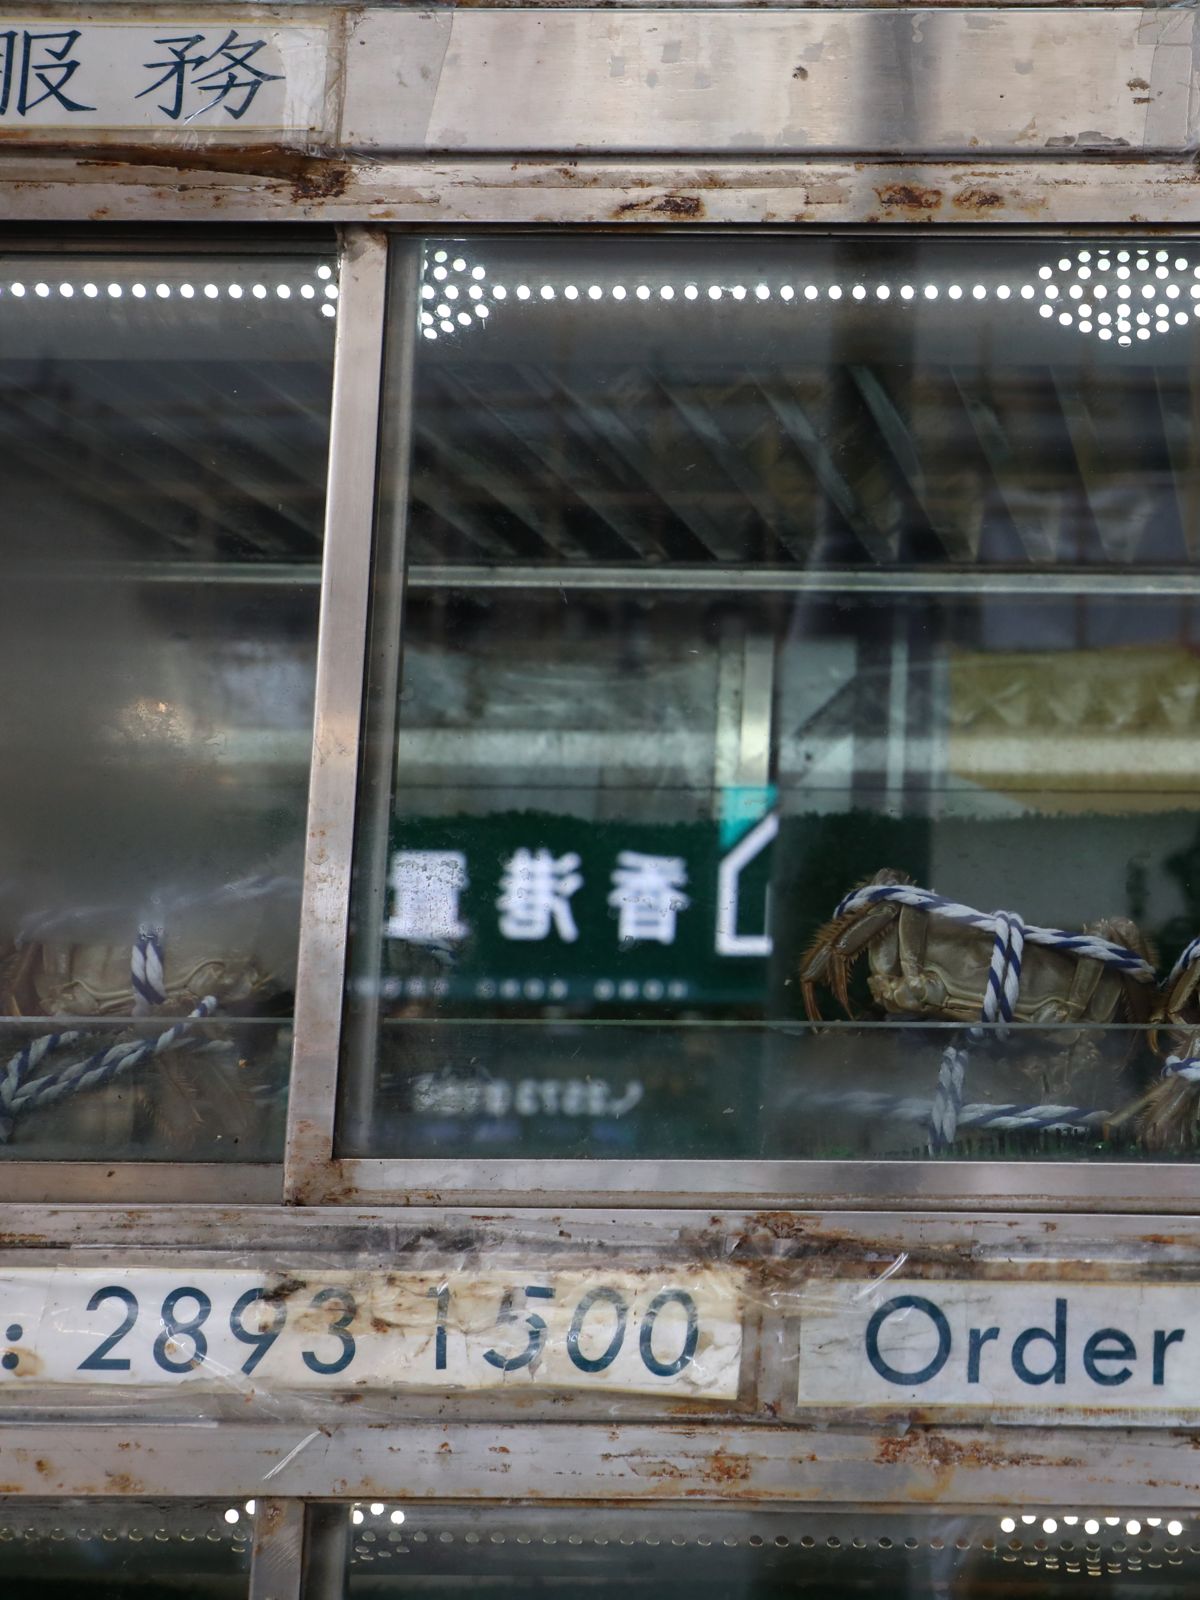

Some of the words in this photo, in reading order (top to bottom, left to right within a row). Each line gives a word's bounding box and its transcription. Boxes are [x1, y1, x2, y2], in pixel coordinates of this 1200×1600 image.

[77, 1285, 357, 1376] 2893
[427, 1285, 700, 1378] 1500
[865, 1294, 1185, 1387] Order
